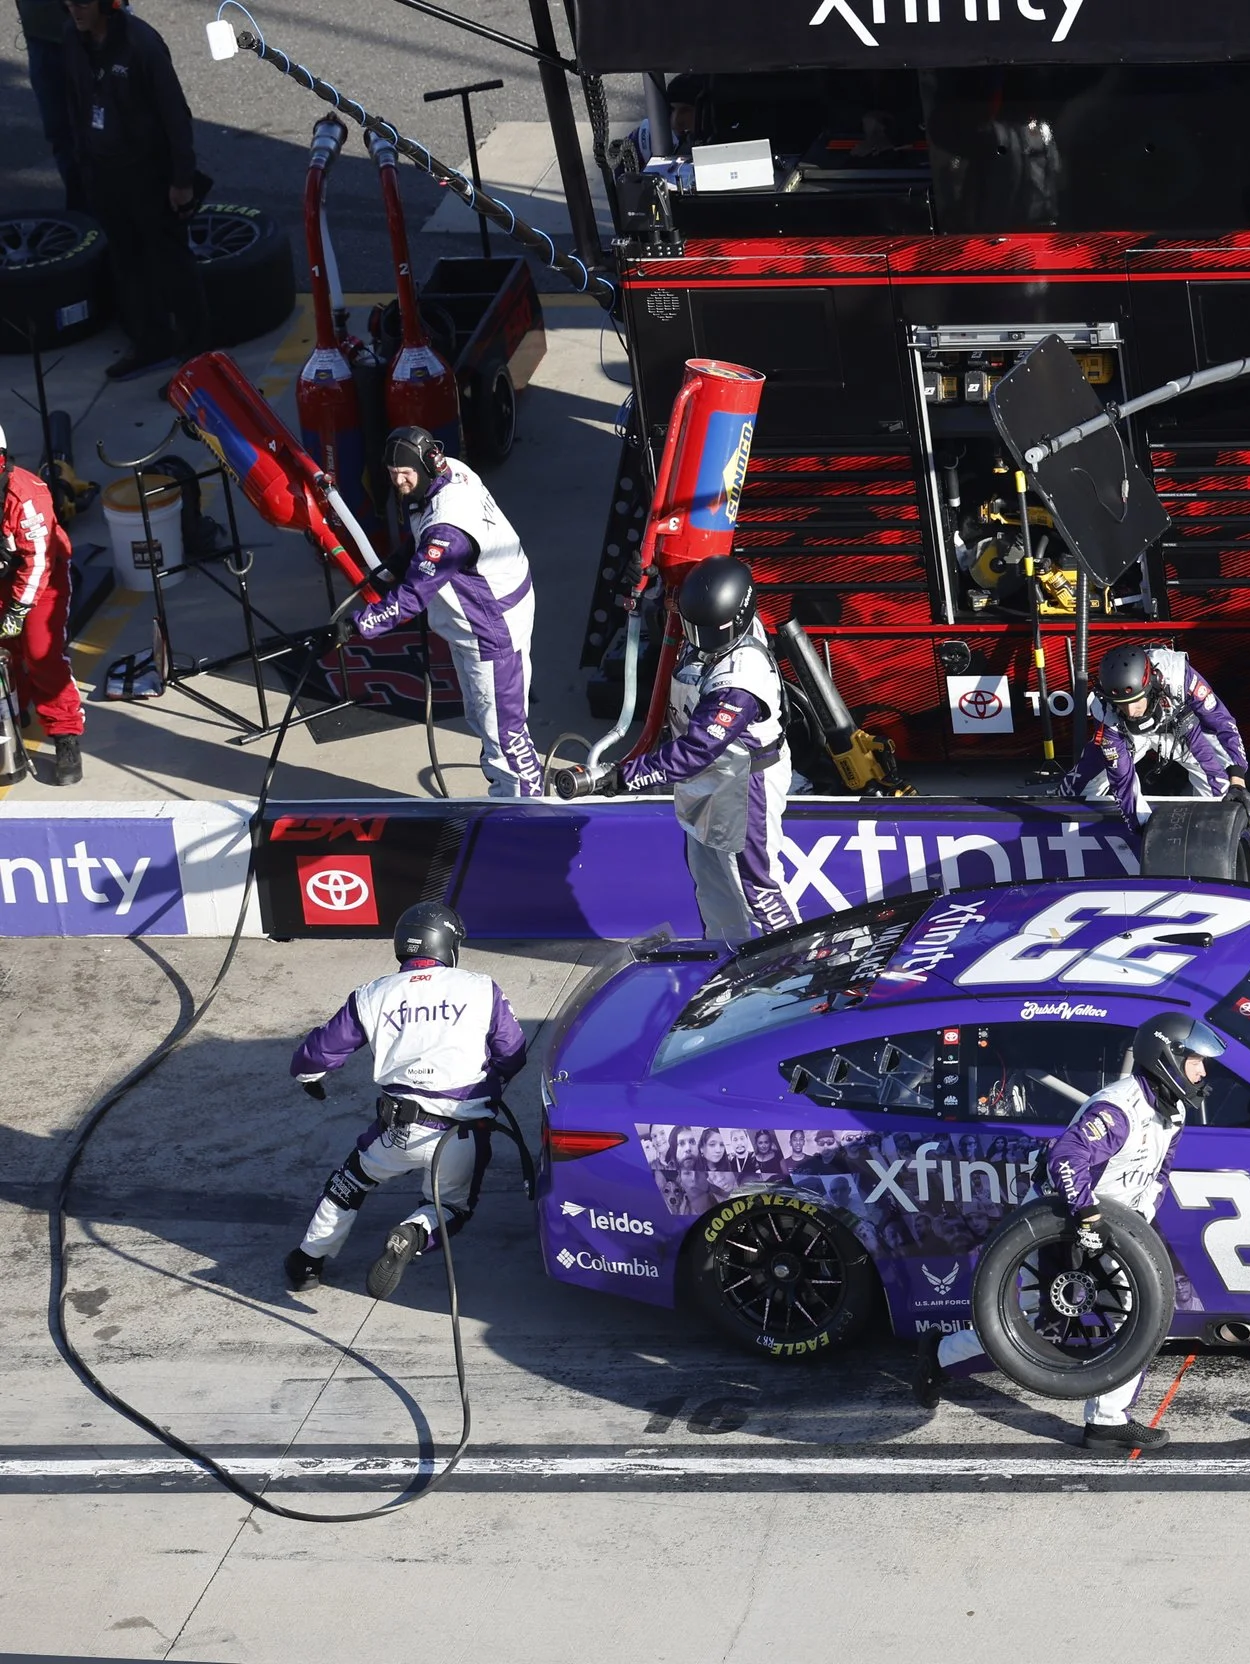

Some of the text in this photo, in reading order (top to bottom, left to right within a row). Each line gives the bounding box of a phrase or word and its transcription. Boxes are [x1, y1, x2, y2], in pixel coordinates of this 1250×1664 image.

[311, 265, 320, 277] 1
[400, 263, 410, 275] 2
[968, 384, 981, 392] 23
[725, 421, 753, 520] SUNOCO
[668, 517, 681, 531] 3
[360, 601, 400, 630] xfinity
[506, 730, 543, 796] xfinity
[626, 768, 668, 792] xfinity
[849, 921, 911, 982] WALLACE
[889, 899, 986, 983] xfinity
[382, 999, 468, 1033] xfinity
[1020, 1001, 1108, 1020] Bubba Wallace
[407, 1068, 427, 1076] Mobil
[864, 1142, 1042, 1213] xfinit
[588, 1209, 655, 1236] leidos
[703, 1193, 819, 1243] GOODYEAR
[576, 1251, 660, 1279] Columbia
[915, 1319, 962, 1333] Mobil
[770, 1330, 831, 1357] EAGLE
